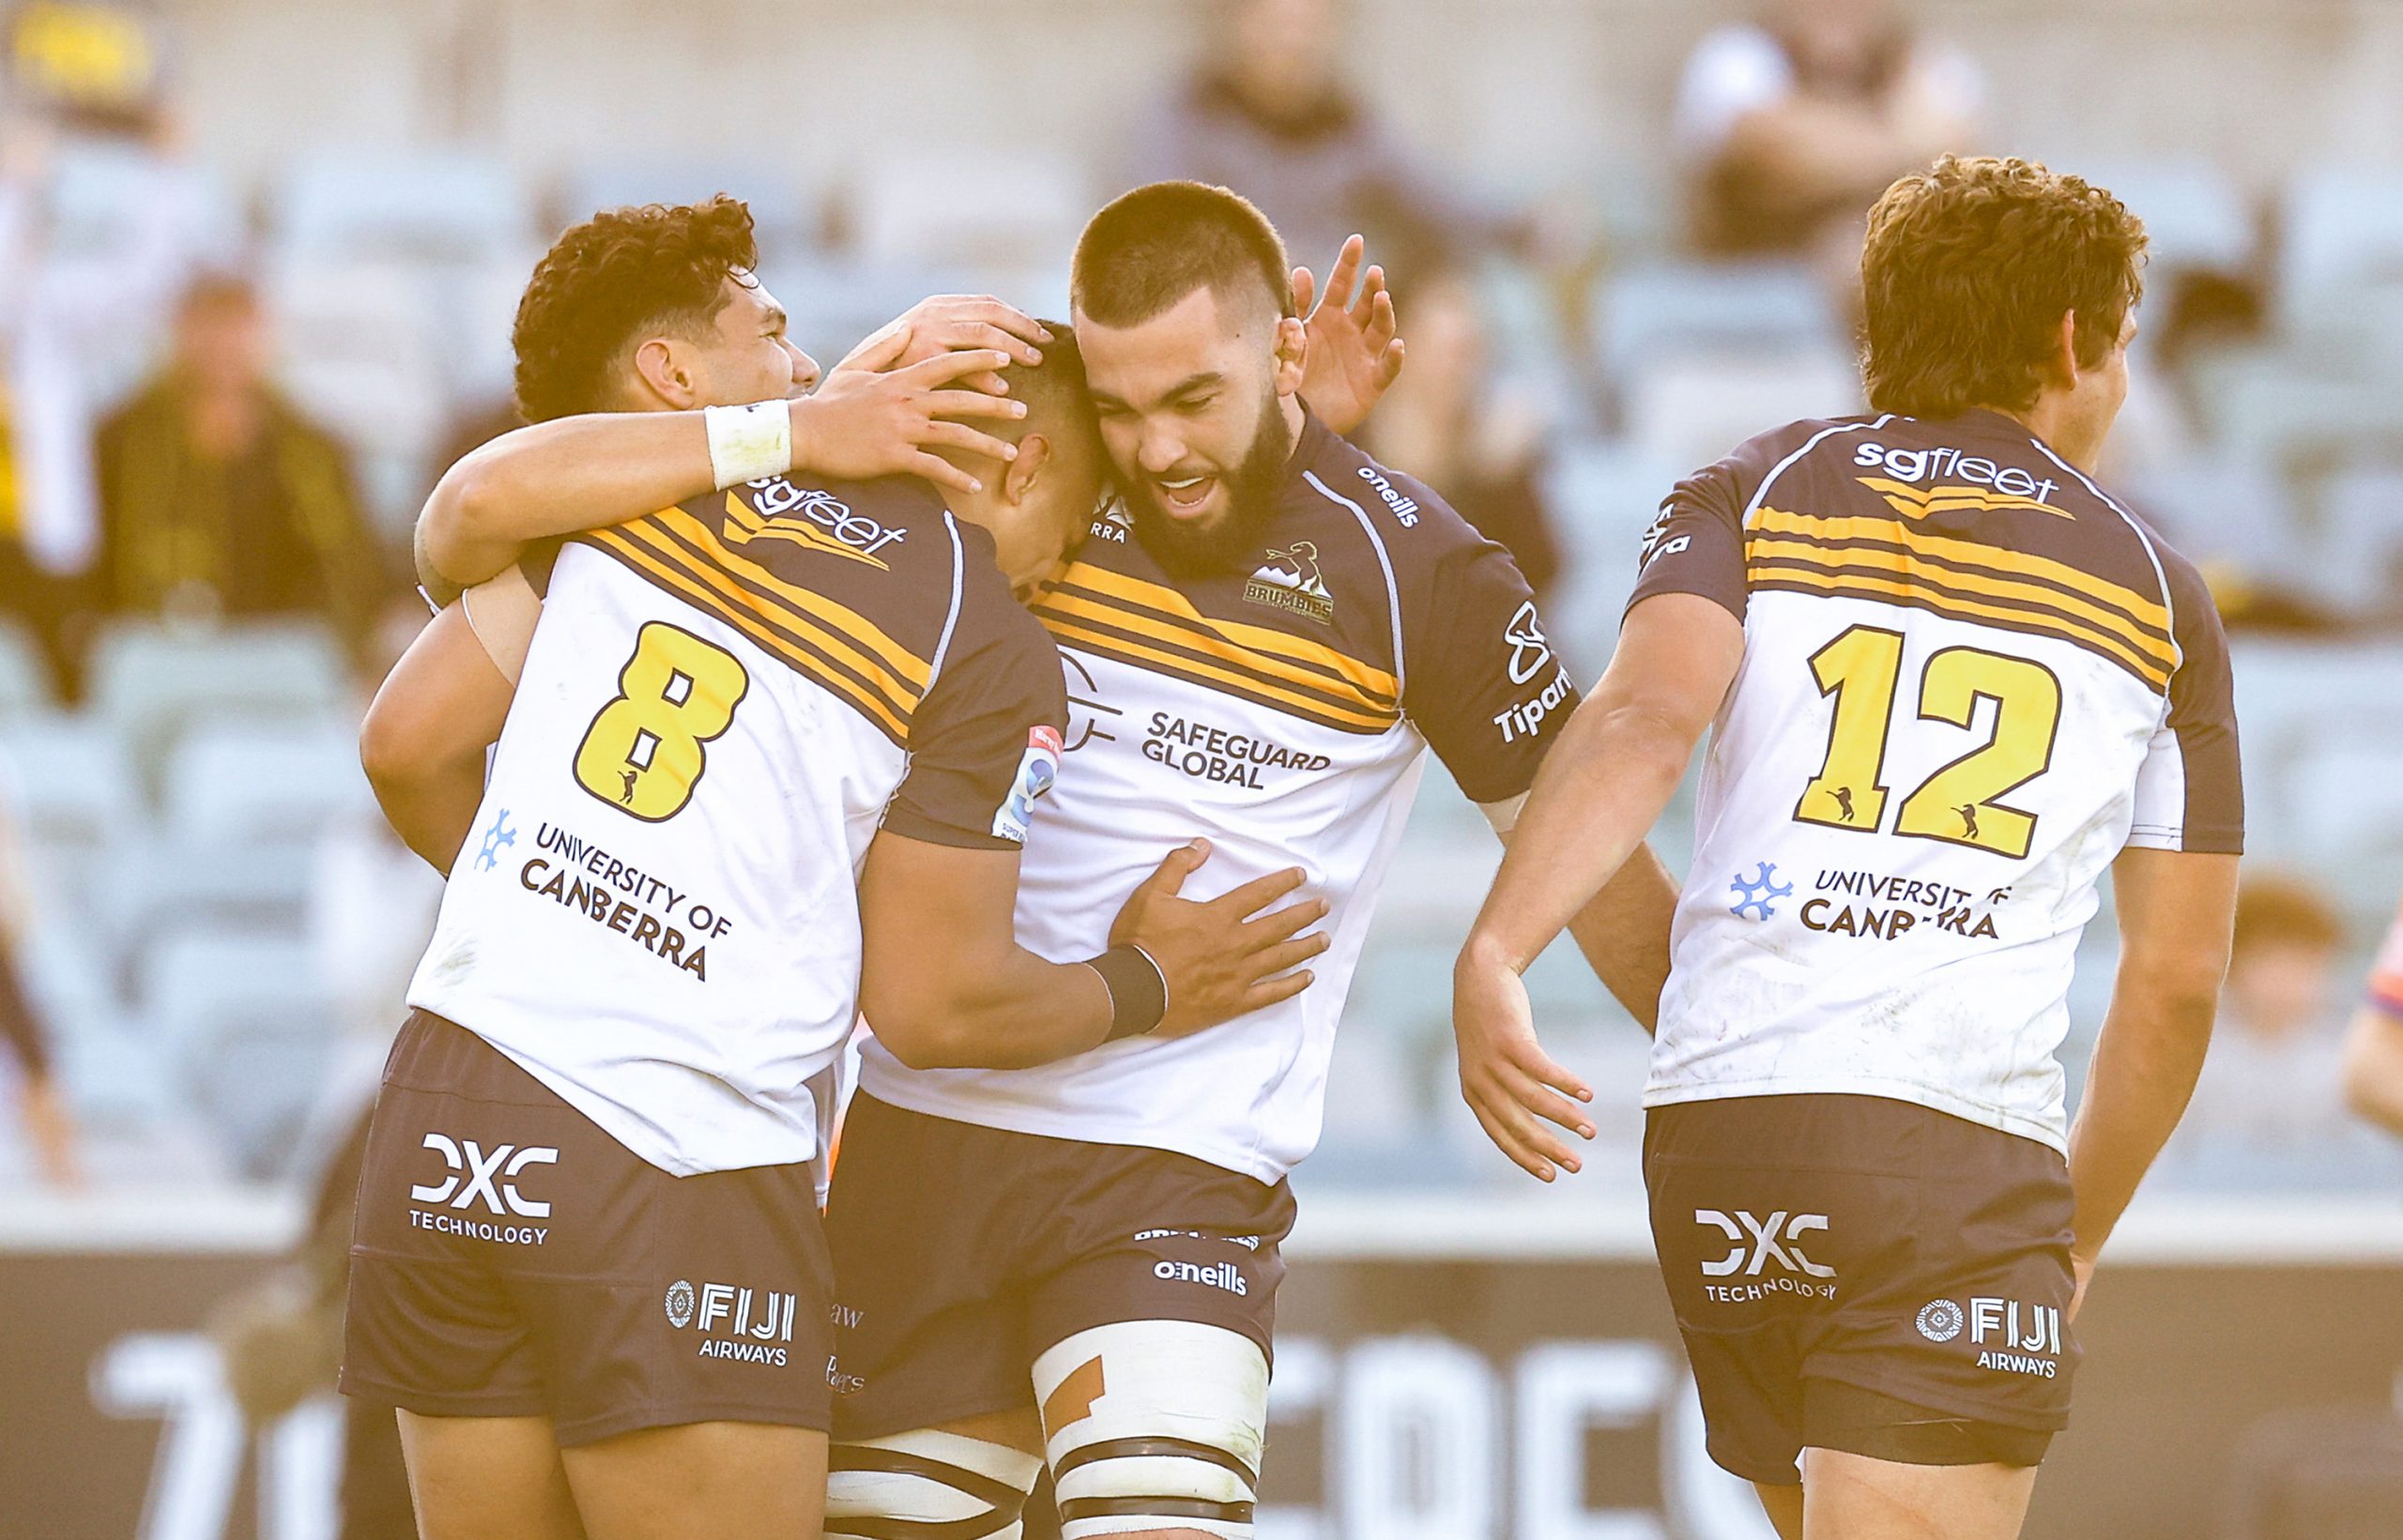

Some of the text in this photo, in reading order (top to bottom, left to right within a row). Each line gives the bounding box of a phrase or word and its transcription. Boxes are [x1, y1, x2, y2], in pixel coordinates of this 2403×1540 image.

[1853, 443, 2059, 504] sgfleet
[1246, 583, 1332, 618] BRUMBIES
[572, 620, 750, 823] 8
[1146, 710, 1332, 772] SAFEGUARD
[1792, 623, 2062, 860] 12
[1140, 739, 1264, 790] GLOBAL
[535, 821, 733, 939] UNIVERSITY OF
[1814, 869, 1972, 910] UNIVERSIT
[520, 858, 706, 983] CANBERRA
[1799, 897, 1999, 941] CANBRRA
[410, 1133, 559, 1218] DXC
[409, 1209, 548, 1245] TECHNOLOGY
[1694, 1209, 1838, 1278] DXC
[697, 1282, 796, 1343] FIJI
[1705, 1277, 1838, 1303] TECHNOLOGY
[698, 1338, 788, 1367] AIRWAYS
[1970, 1297, 2061, 1356] FIJI
[1976, 1350, 2058, 1380] AIRWAYS
